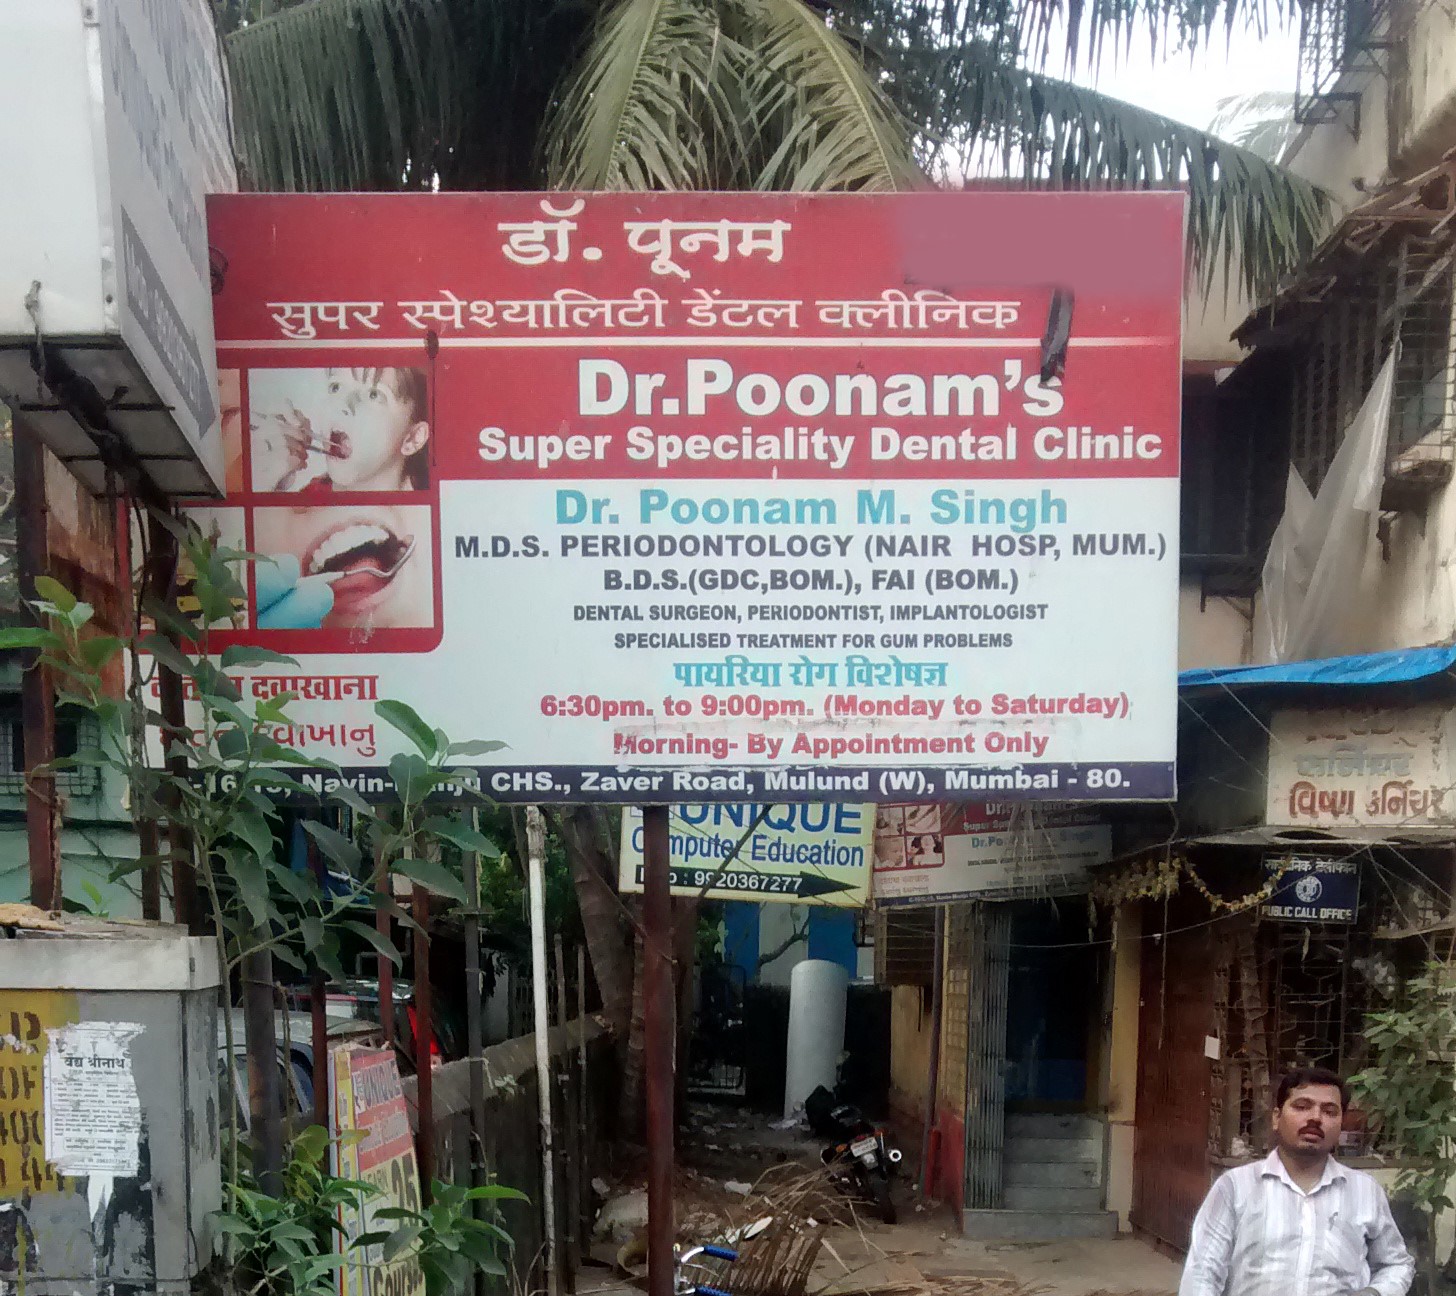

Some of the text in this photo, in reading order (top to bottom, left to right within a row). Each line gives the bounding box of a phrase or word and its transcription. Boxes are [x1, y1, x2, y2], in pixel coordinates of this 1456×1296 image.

[497, 198, 792, 281] डॉ. पूनम
[266, 288, 1022, 339] सुपर स्पेश्यालिटी डेंटल क्लीनिक
[478, 425, 1163, 470] Super Speciality Dental Clinic
[556, 489, 1067, 533] Dr. Poonam M. Singh
[455, 533, 1166, 563] M.D.S. PERIODONTOLOGY (NAIR HOSP, MUM.)
[872, 569, 914, 591] FAI
[925, 569, 1019, 595] (BOM.)
[573, 603, 1048, 624] DENTAL SURGEON, PERIODONTIST, IMPLANTOLOGIST
[614, 633, 1013, 649] SPECIALISED TREATMENT FOR GUM PROBLEMS
[673, 654, 782, 687] पायरिया
[788, 654, 838, 687] रोग
[540, 691, 1129, 721] 6:30pm. to 9:00pm. (Monday to Saturday)
[747, 732, 783, 759] By
[791, 731, 975, 758] Appointment
[985, 731, 1049, 757] Only
[491, 771, 570, 795] CHS.,
[580, 771, 663, 791] Zaver
[673, 771, 753, 795] Road,
[764, 770, 869, 791] Mulund
[879, 769, 935, 795] (W),
[945, 768, 1058, 790] Mumbai
[1086, 768, 1130, 789] 80.
[631, 826, 864, 867] Cmputer Education
[1261, 905, 1352, 920] PUBLIC CALL OFFICE
